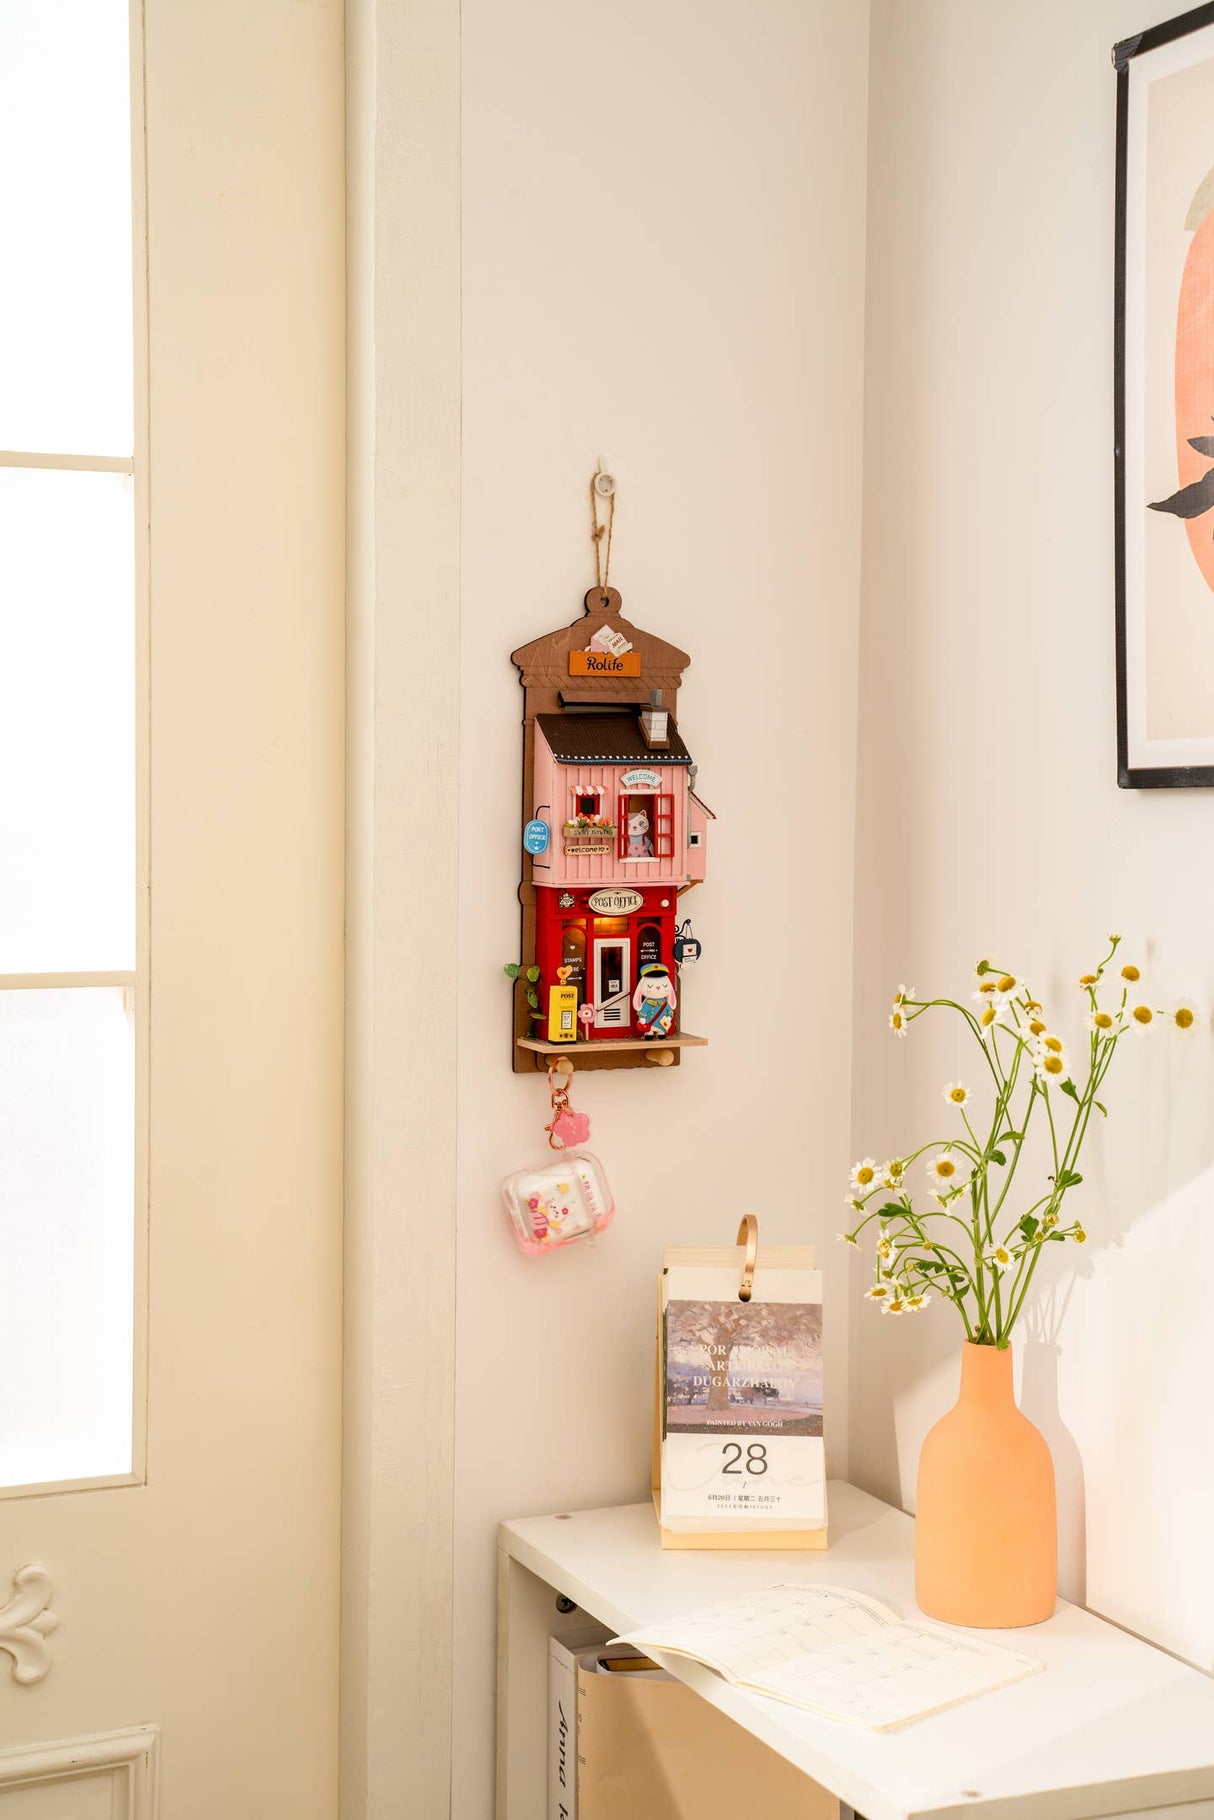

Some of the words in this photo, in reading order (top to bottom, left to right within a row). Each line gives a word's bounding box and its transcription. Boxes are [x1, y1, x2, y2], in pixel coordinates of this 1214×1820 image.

[587, 656, 623, 671] Rolife
[626, 771, 657, 783] WELCOME
[593, 896, 612, 908] POST
[613, 895, 638, 908] OFFICE
[706, 1419, 737, 1427] PAINTED
[721, 1442, 769, 1476] 28
[558, 1700, 569, 1788] Anna
